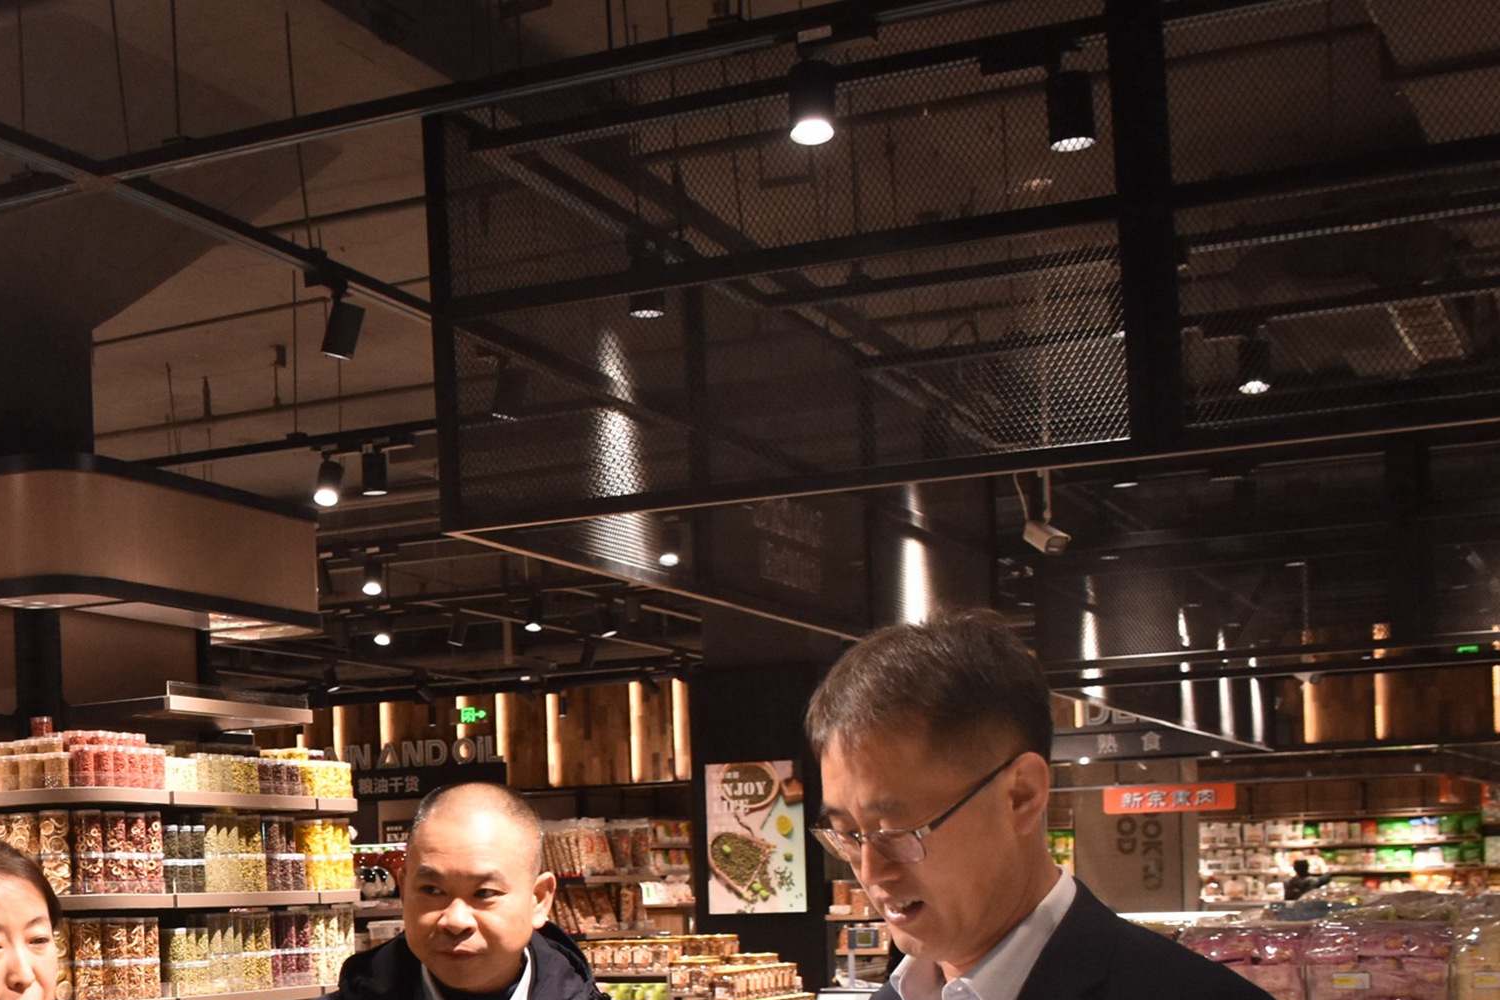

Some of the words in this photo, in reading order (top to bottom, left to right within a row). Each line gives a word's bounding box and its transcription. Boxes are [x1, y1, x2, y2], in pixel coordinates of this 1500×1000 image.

[377, 740, 447, 768] AND
[358, 776, 419, 794] 粮油干货
[712, 781, 766, 796] ENJOY
